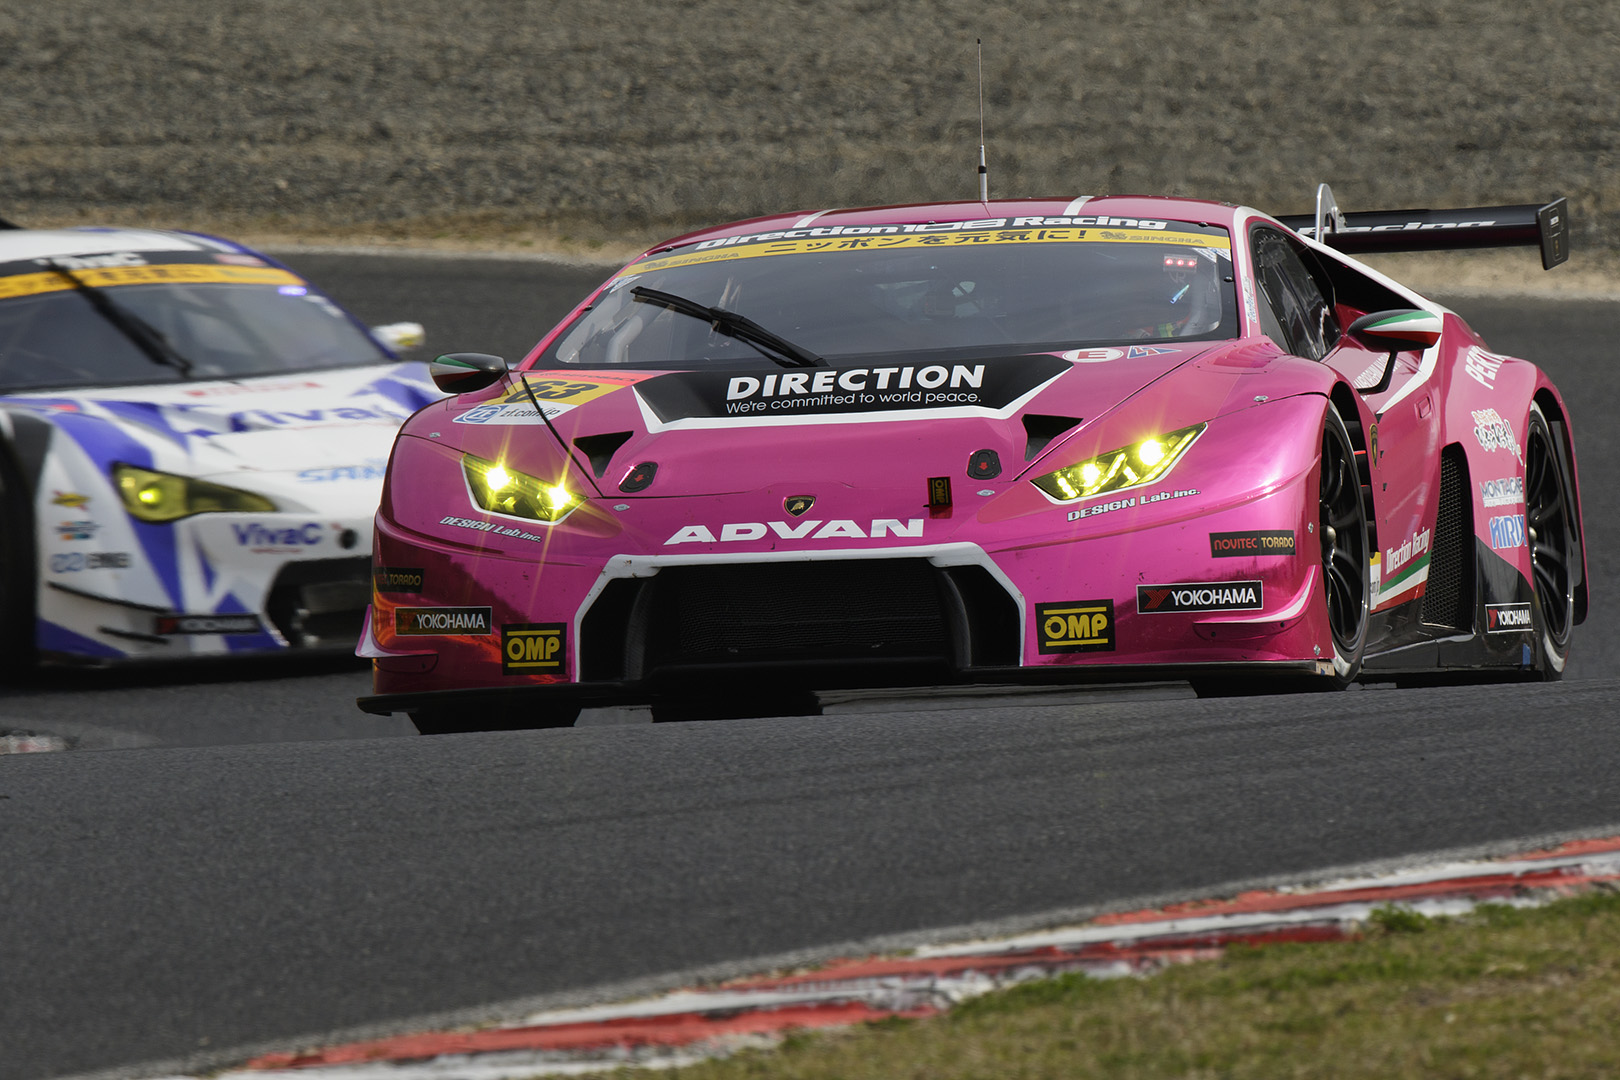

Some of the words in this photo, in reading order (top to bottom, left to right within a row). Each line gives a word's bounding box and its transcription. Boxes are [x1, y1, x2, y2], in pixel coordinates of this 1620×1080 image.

[695, 226, 899, 250] Direction
[1011, 216, 1168, 230] Racing
[1128, 235, 1206, 245] SINGHA
[669, 252, 740, 266] SINGHA
[503, 380, 600, 404] 63
[726, 365, 986, 400] DIRECTION
[726, 401, 767, 414] We're
[771, 393, 855, 410] committed
[859, 392, 875, 404] to
[879, 391, 922, 403] world
[925, 390, 982, 404] peace.
[935, 479, 946, 504] OMP
[1067, 497, 1136, 522] DESIGN
[1140, 487, 1201, 506] Lab.inc.
[439, 515, 497, 532] DESIGN
[492, 525, 542, 543] Lab.inc.
[663, 518, 925, 546] ADVAN
[1213, 537, 1258, 551] NOVITEC
[1260, 536, 1294, 549] TORADO
[389, 573, 422, 586] TORADO
[1171, 587, 1257, 606] YOKOHAMA
[416, 613, 486, 630] YOKOHAMA
[1043, 613, 1108, 640] OMP
[1497, 609, 1531, 626] YOKOHAMA
[505, 636, 560, 661] OMP
